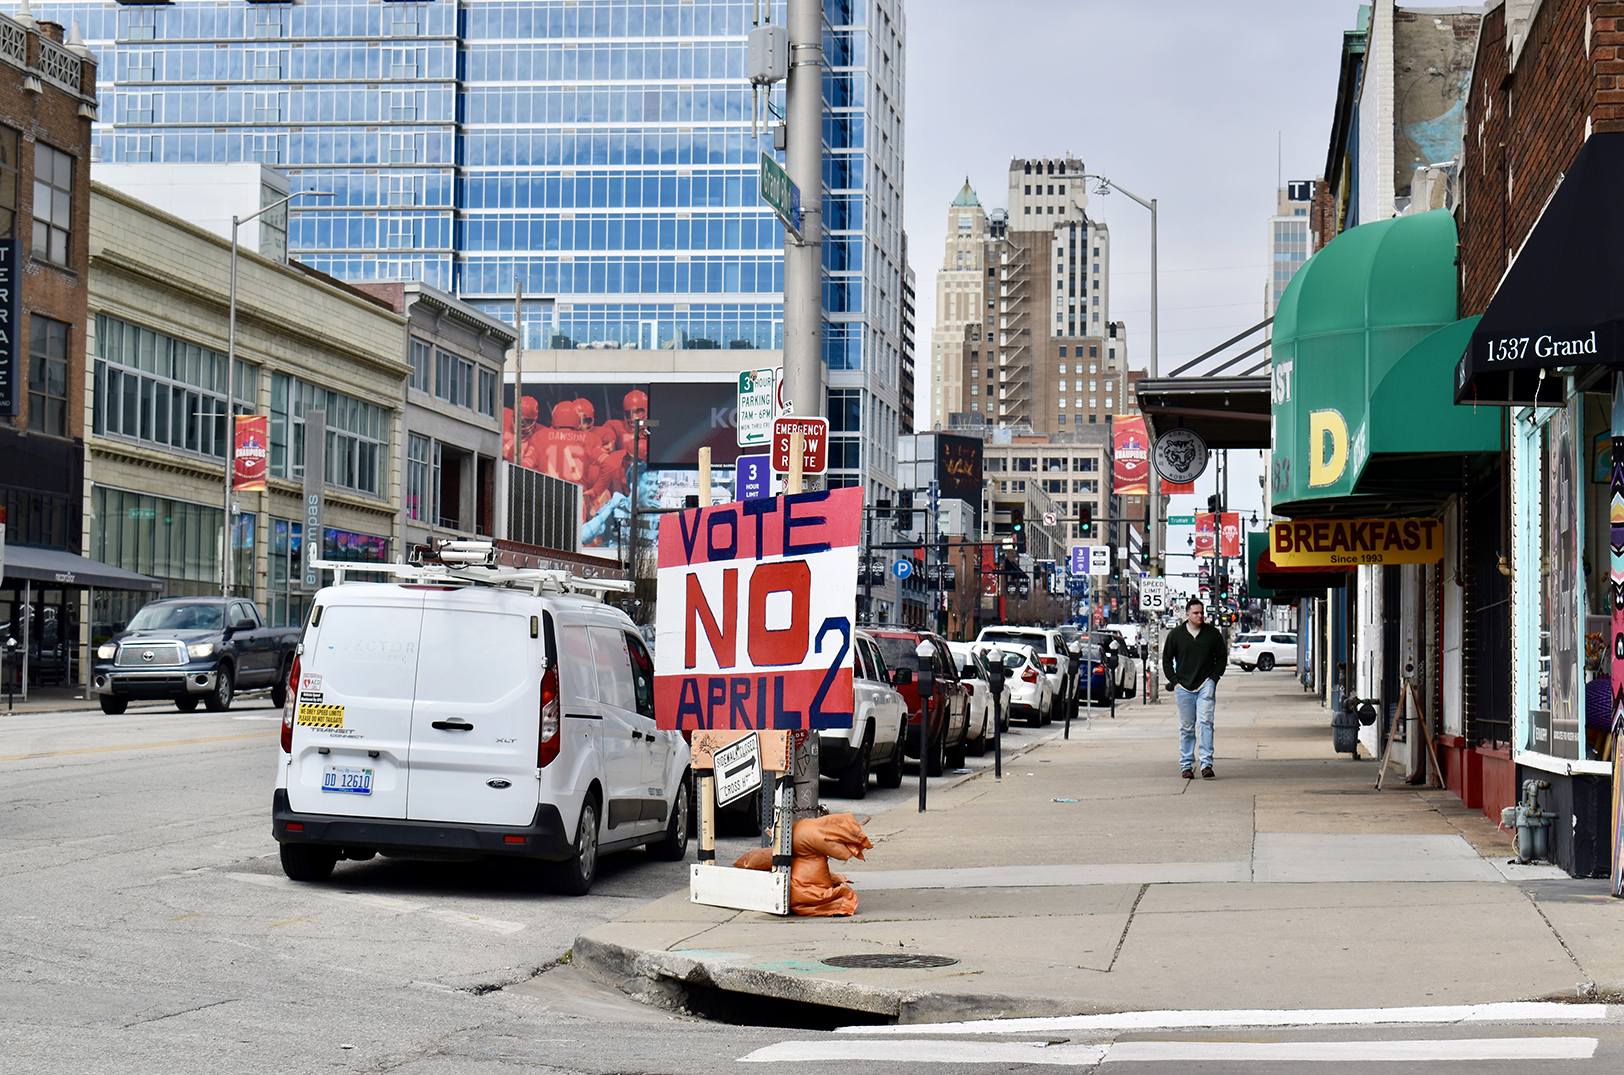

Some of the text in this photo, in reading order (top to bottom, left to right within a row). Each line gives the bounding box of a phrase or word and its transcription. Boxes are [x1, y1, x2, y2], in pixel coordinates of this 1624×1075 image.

[764, 162, 779, 203] Grand
[1487, 331, 1597, 362] 1537 Grand
[744, 377, 771, 390] 3 HOUR
[742, 394, 770, 407] PARKING
[742, 411, 753, 420] 7AM
[760, 409, 770, 419] 6PM
[549, 431, 586, 442] DAWSON
[776, 423, 824, 436] EMERGENCY
[781, 438, 818, 453] SOW
[1308, 408, 1350, 489] D
[545, 445, 584, 481] 16
[782, 456, 816, 467] RTE
[749, 464, 757, 480] 3
[679, 490, 832, 566] VOTE
[1274, 521, 1437, 553] BREAKFAST
[1330, 554, 1383, 564] Since 1993
[898, 563, 908, 575] P
[1143, 595, 1162, 606] 35
[685, 560, 811, 669] NO
[676, 616, 853, 730] APRIL 2
[325, 773, 370, 789] DD 12610
[724, 780, 740, 796] CROSS
